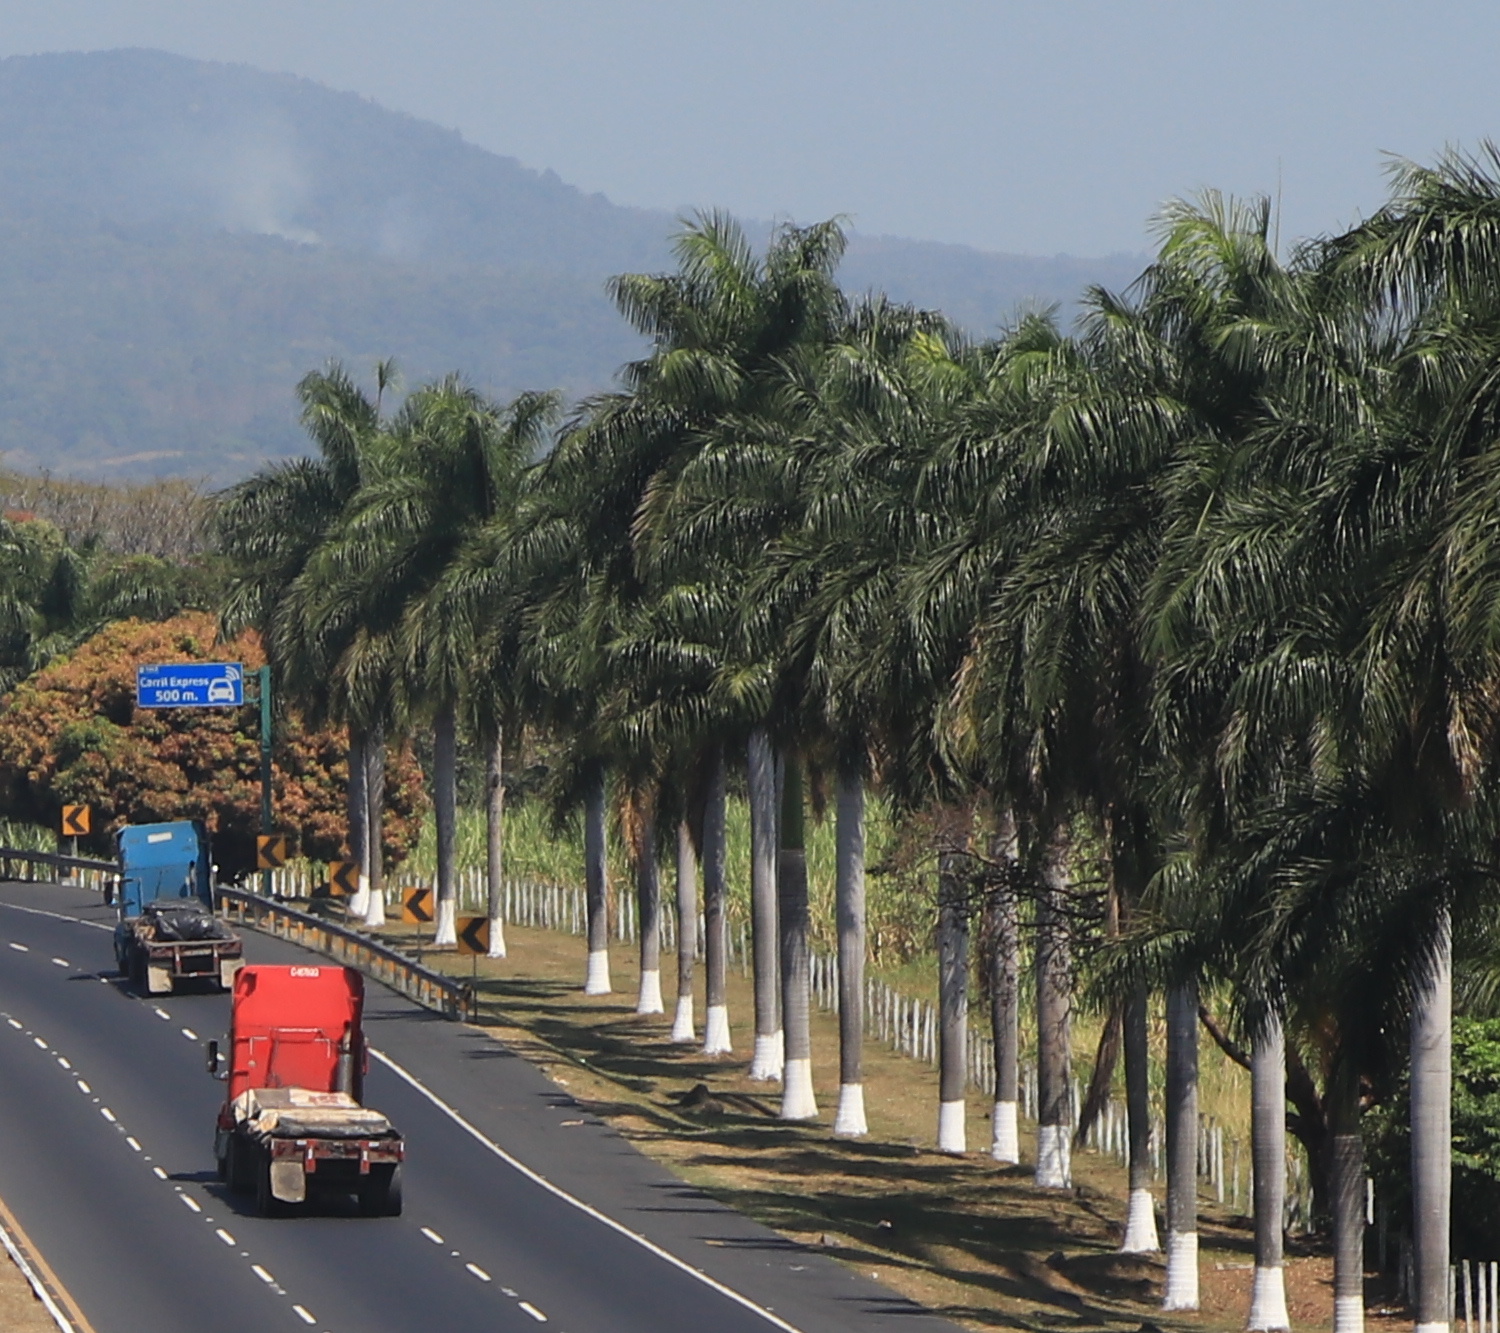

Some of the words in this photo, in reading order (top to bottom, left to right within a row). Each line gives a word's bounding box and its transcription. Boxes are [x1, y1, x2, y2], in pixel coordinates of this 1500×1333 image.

[140, 677, 168, 688] Carril
[170, 677, 209, 689] Express
[156, 690, 180, 702] 500
[183, 691, 199, 701] m.
